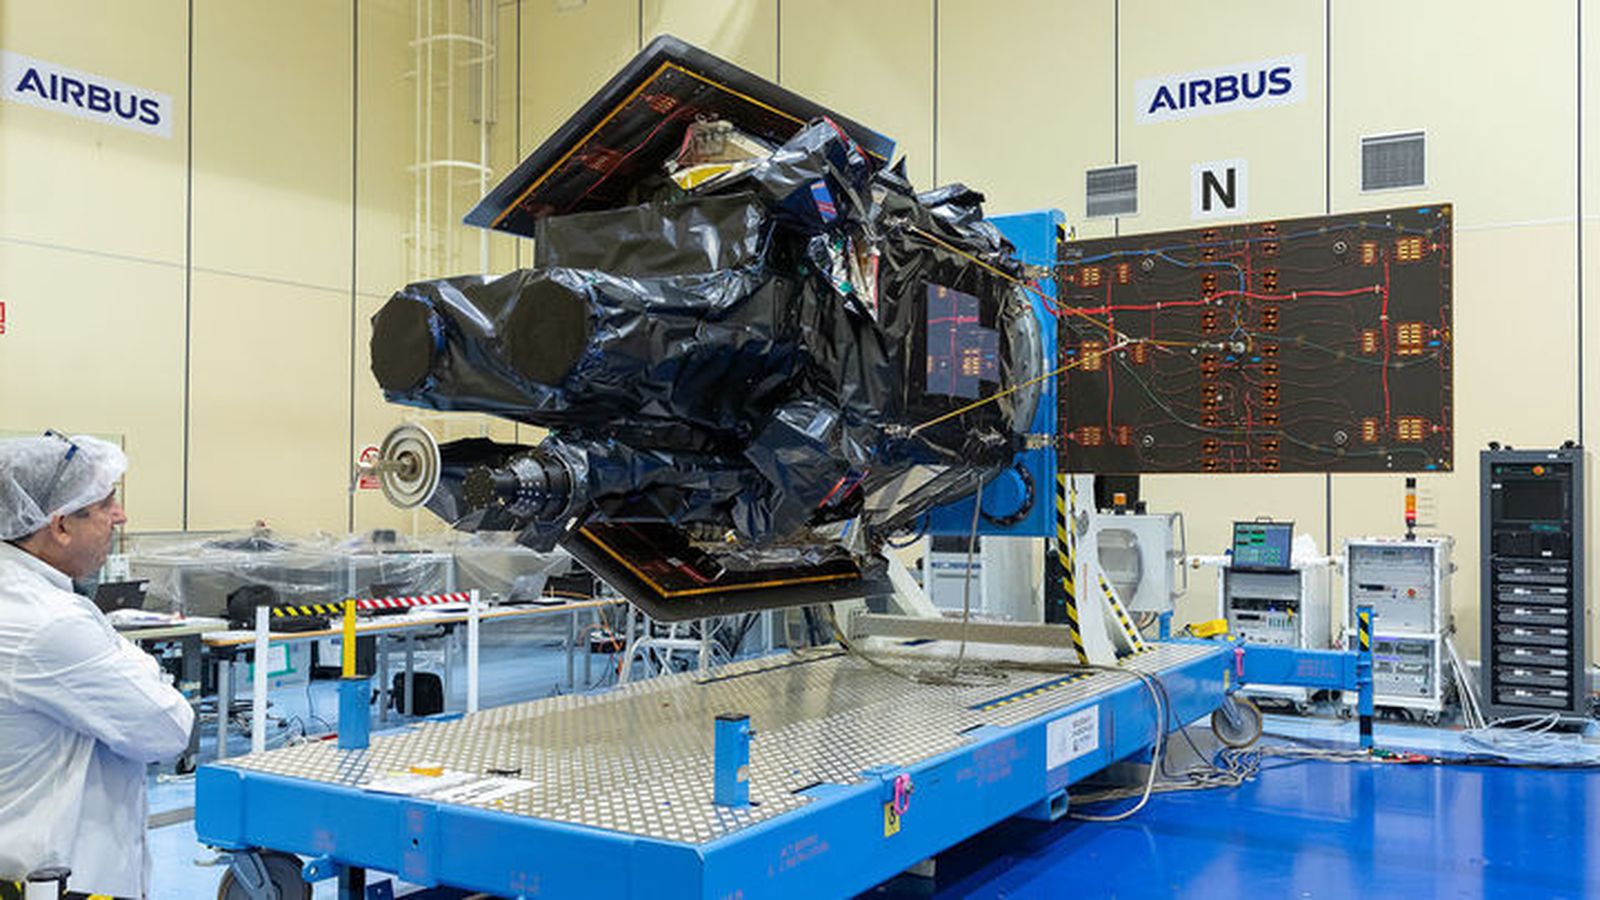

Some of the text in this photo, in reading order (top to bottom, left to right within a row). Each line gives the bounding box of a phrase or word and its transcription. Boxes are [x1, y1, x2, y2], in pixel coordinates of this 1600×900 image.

[16, 68, 161, 126] AIRBUS
[1149, 67, 1292, 114] AIRBUS
[1202, 167, 1236, 212] N
